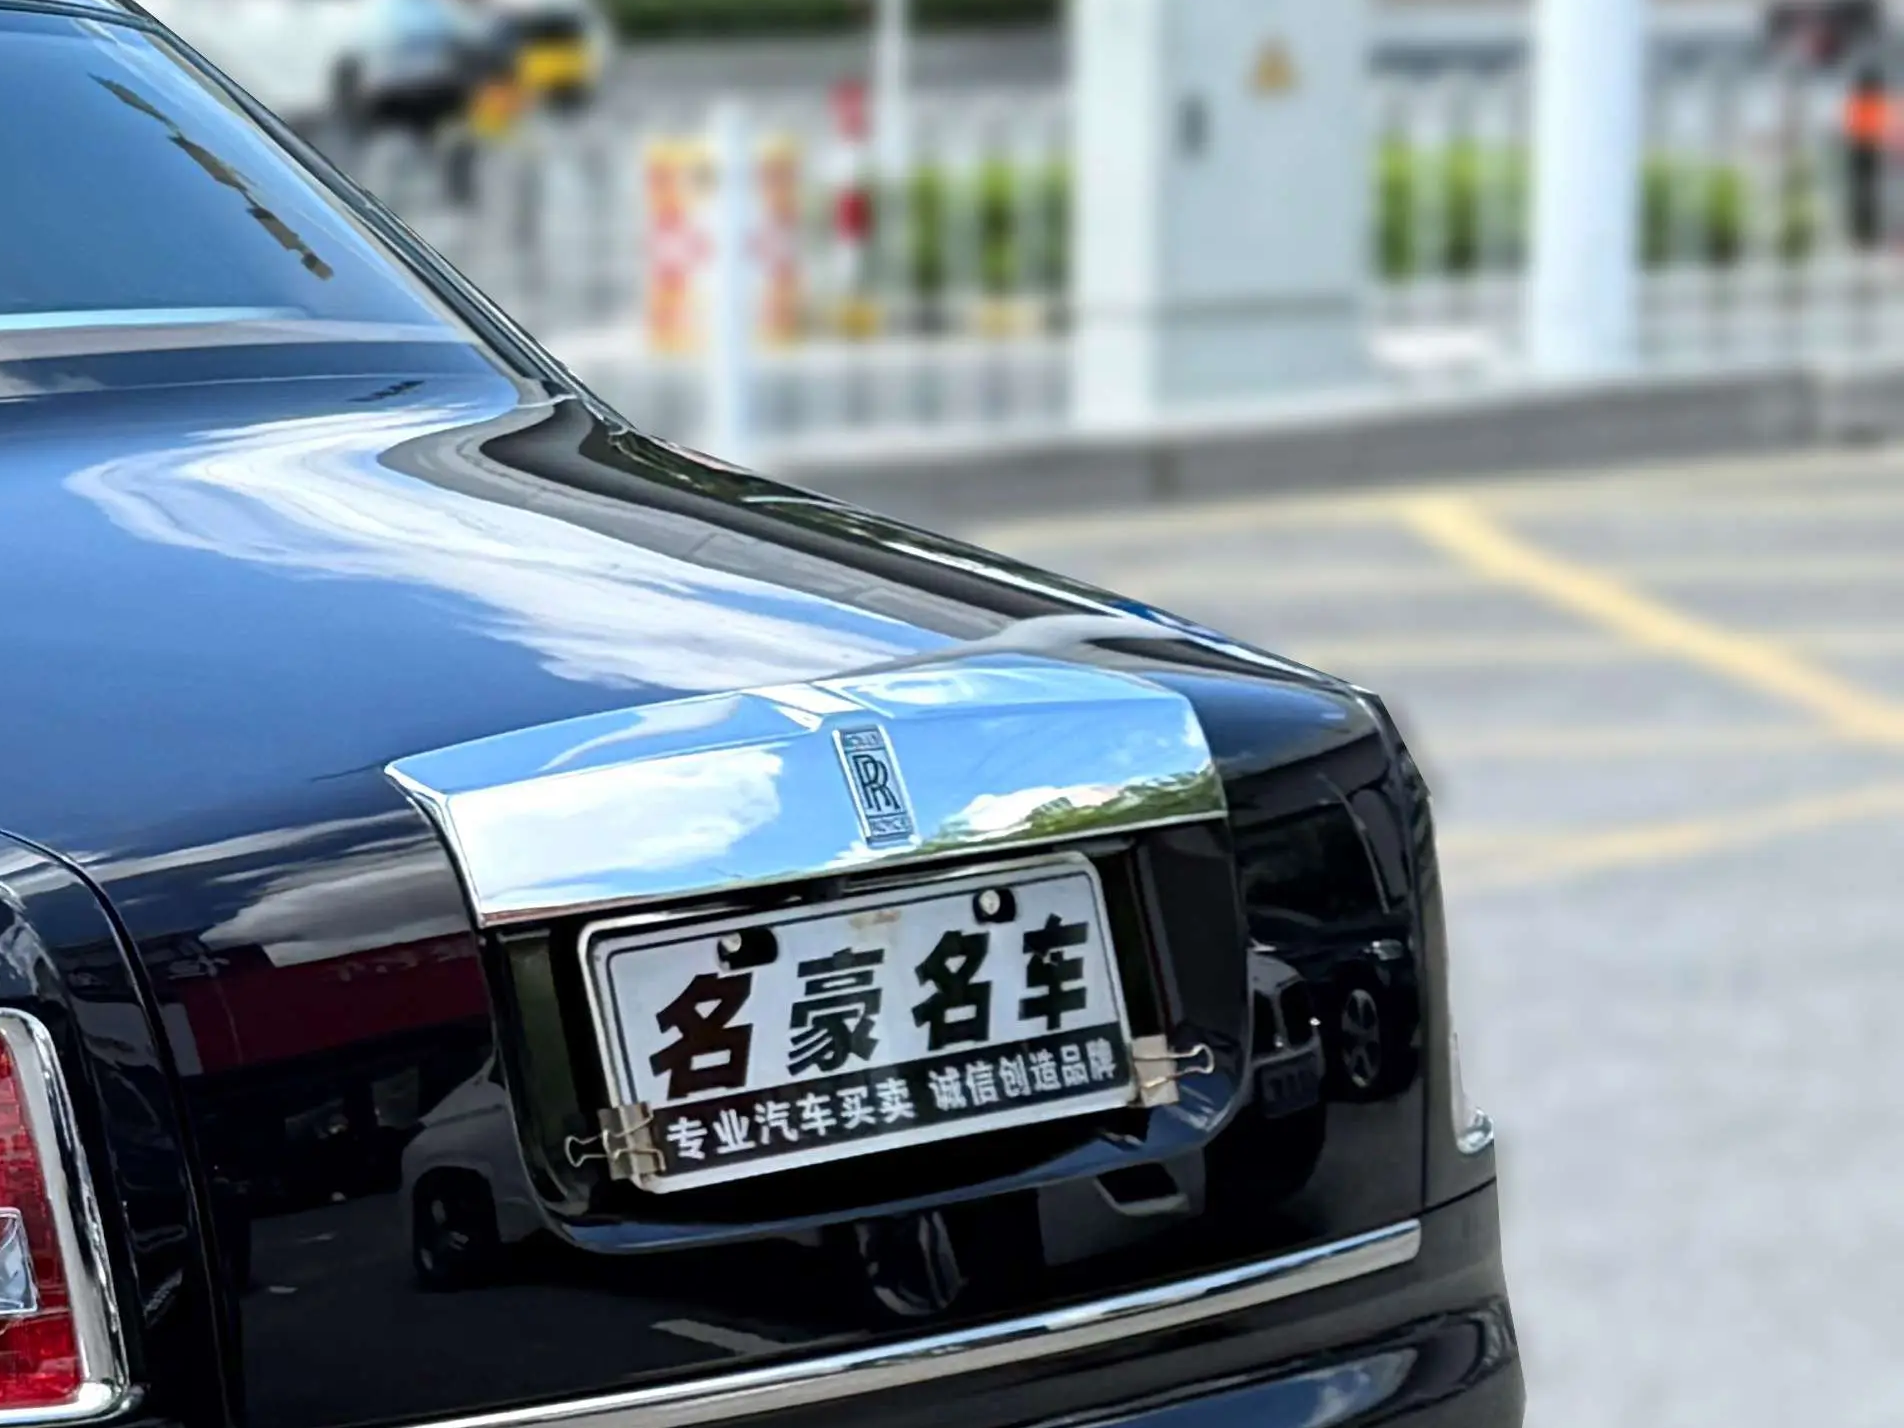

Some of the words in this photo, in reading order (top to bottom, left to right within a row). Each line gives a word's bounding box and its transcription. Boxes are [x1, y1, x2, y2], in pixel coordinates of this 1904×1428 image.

[649, 913, 1091, 1100] 名豪名车
[666, 1076, 916, 1161] 专业汽车买卖
[927, 1037, 1117, 1111] 诚信创造品牌
